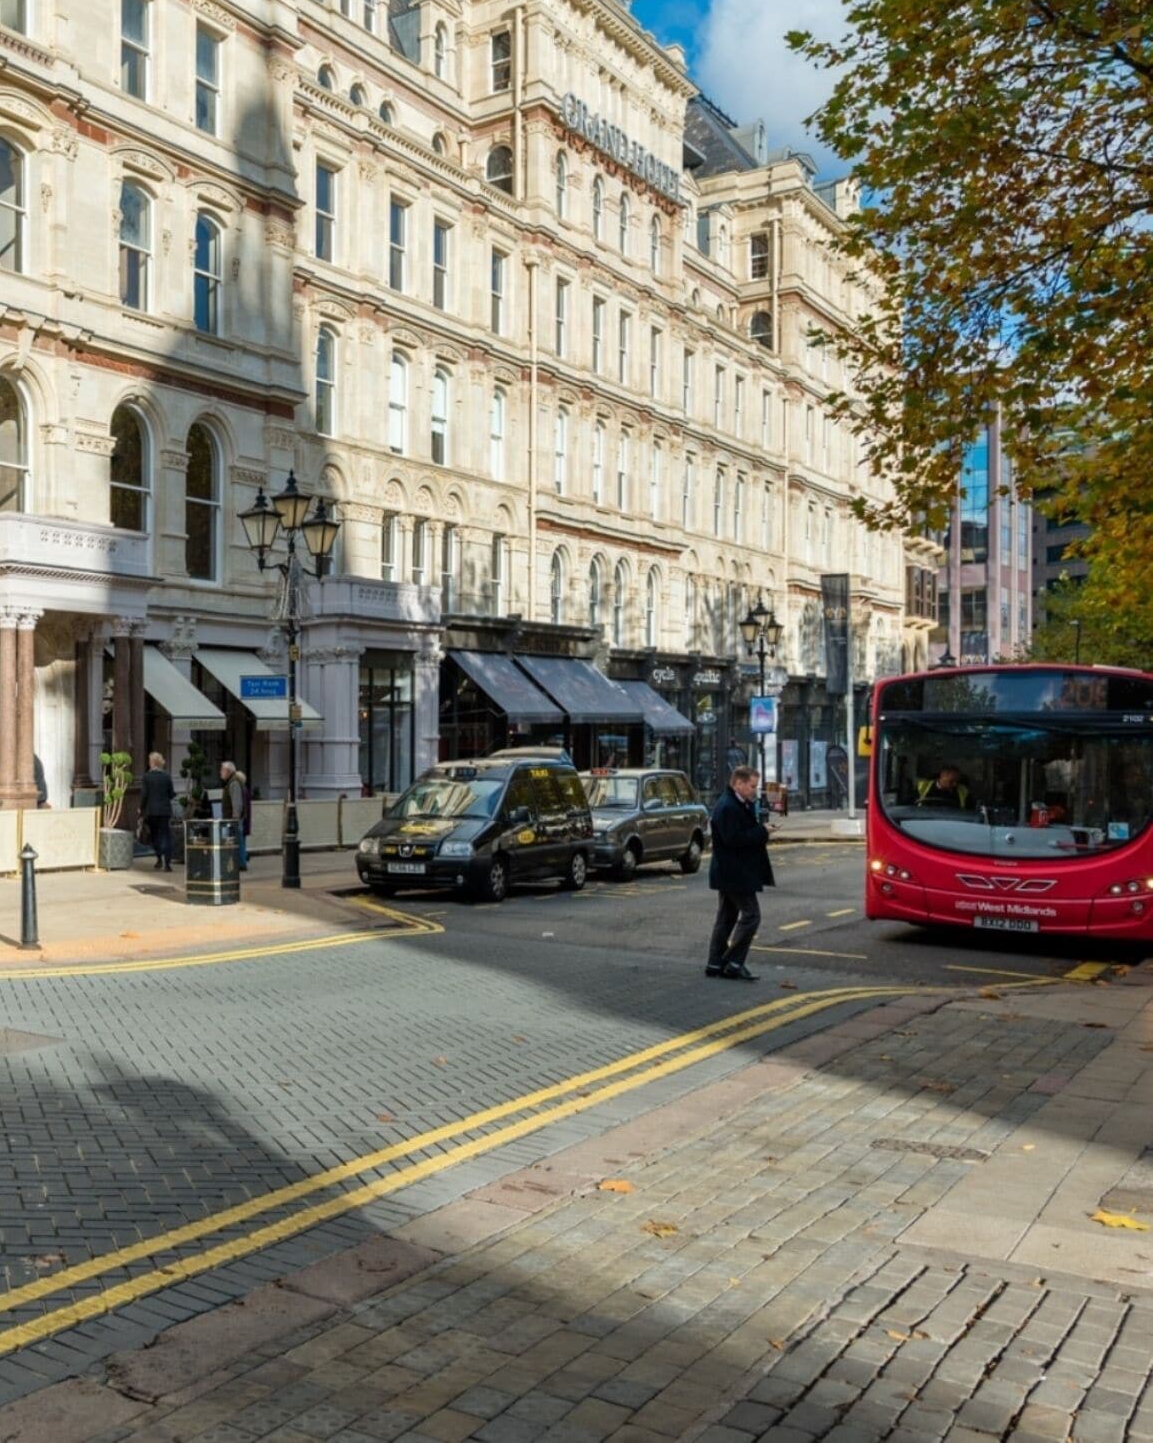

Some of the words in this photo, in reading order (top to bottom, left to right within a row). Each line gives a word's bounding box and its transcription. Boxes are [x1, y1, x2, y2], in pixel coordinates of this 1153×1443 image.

[563, 92, 629, 163] GRAND
[632, 141, 679, 203] HOTEL
[978, 900, 1005, 913] West
[1006, 903, 1057, 917] Midlands
